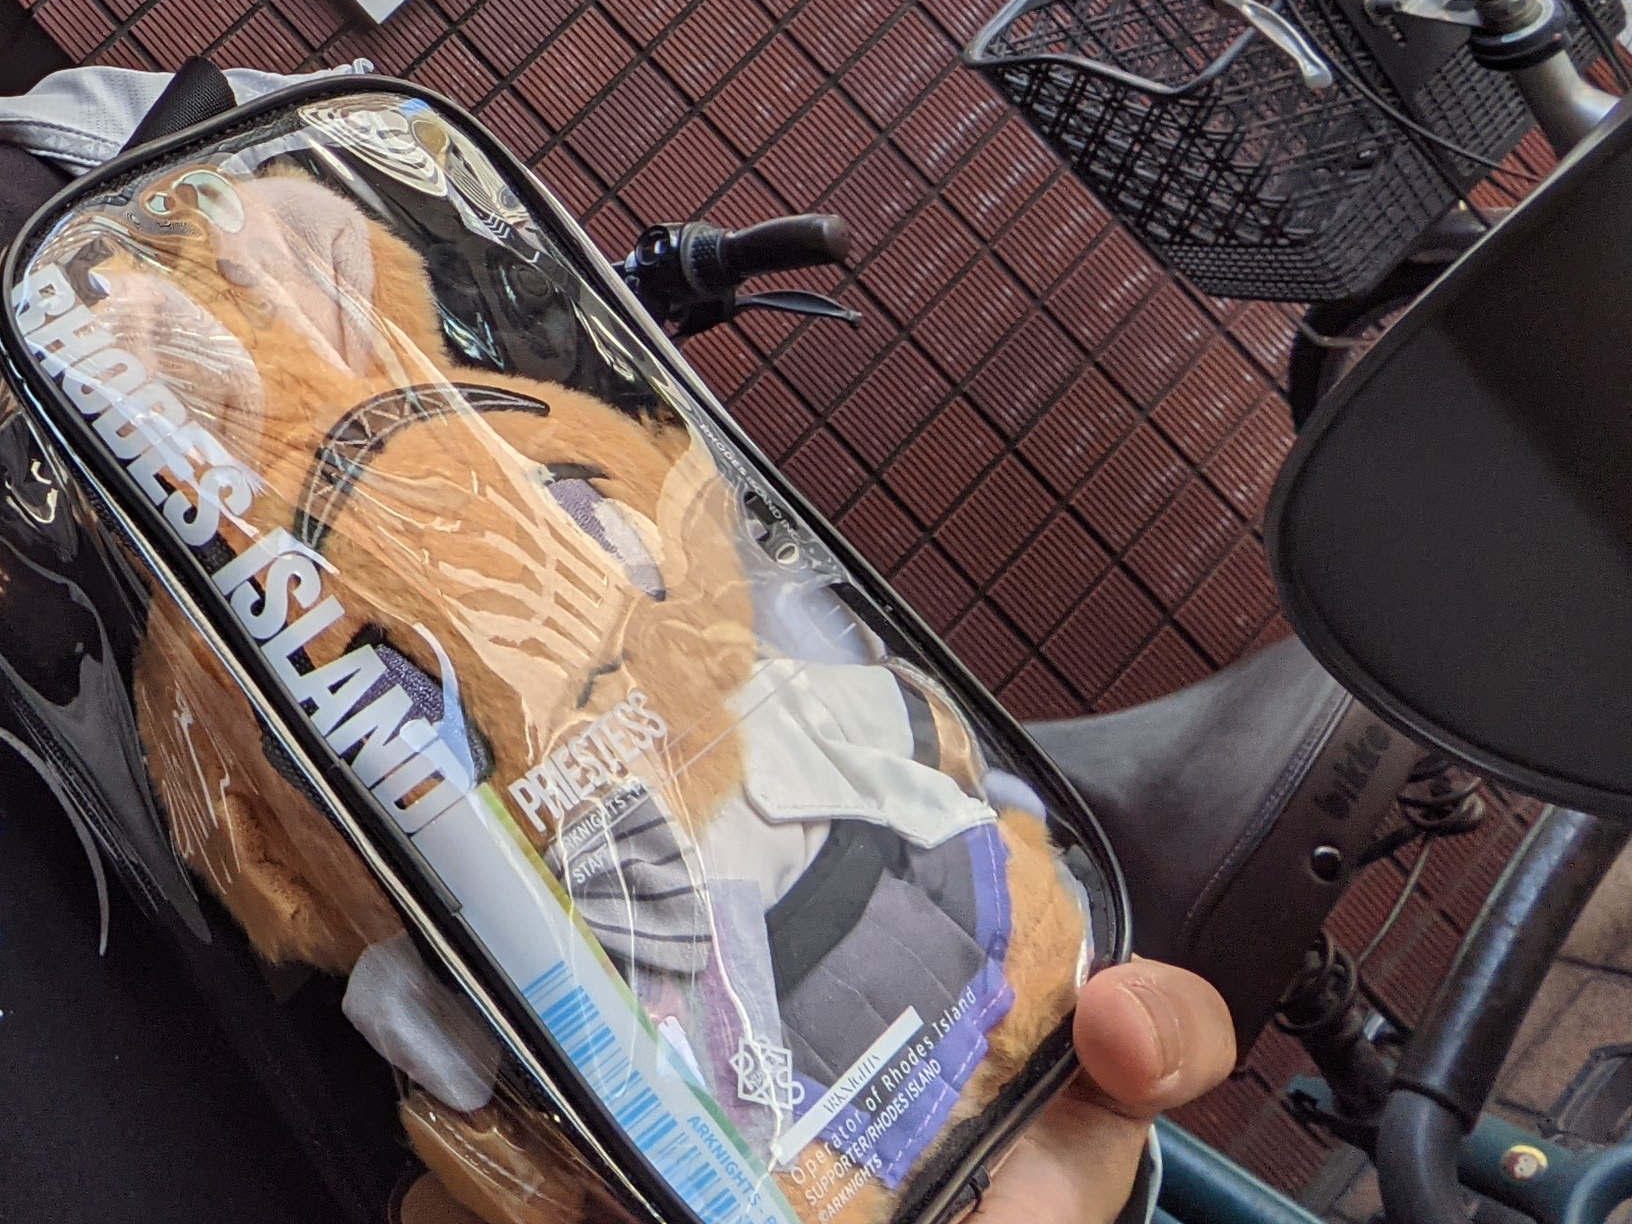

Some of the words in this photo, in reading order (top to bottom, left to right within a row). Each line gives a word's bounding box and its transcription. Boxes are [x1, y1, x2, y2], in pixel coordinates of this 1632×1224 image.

[11, 266, 252, 547] RHODES
[212, 527, 468, 836] ISLAND
[507, 690, 667, 834] PRIESTESS
[790, 1108, 863, 1186] Operator
[865, 1088, 883, 1112] of
[883, 1039, 934, 1090] Rhodes
[932, 986, 976, 1039] Island
[907, 1058, 942, 1105] ISLAND
[687, 1115, 761, 1206] ARKNIGHTS
